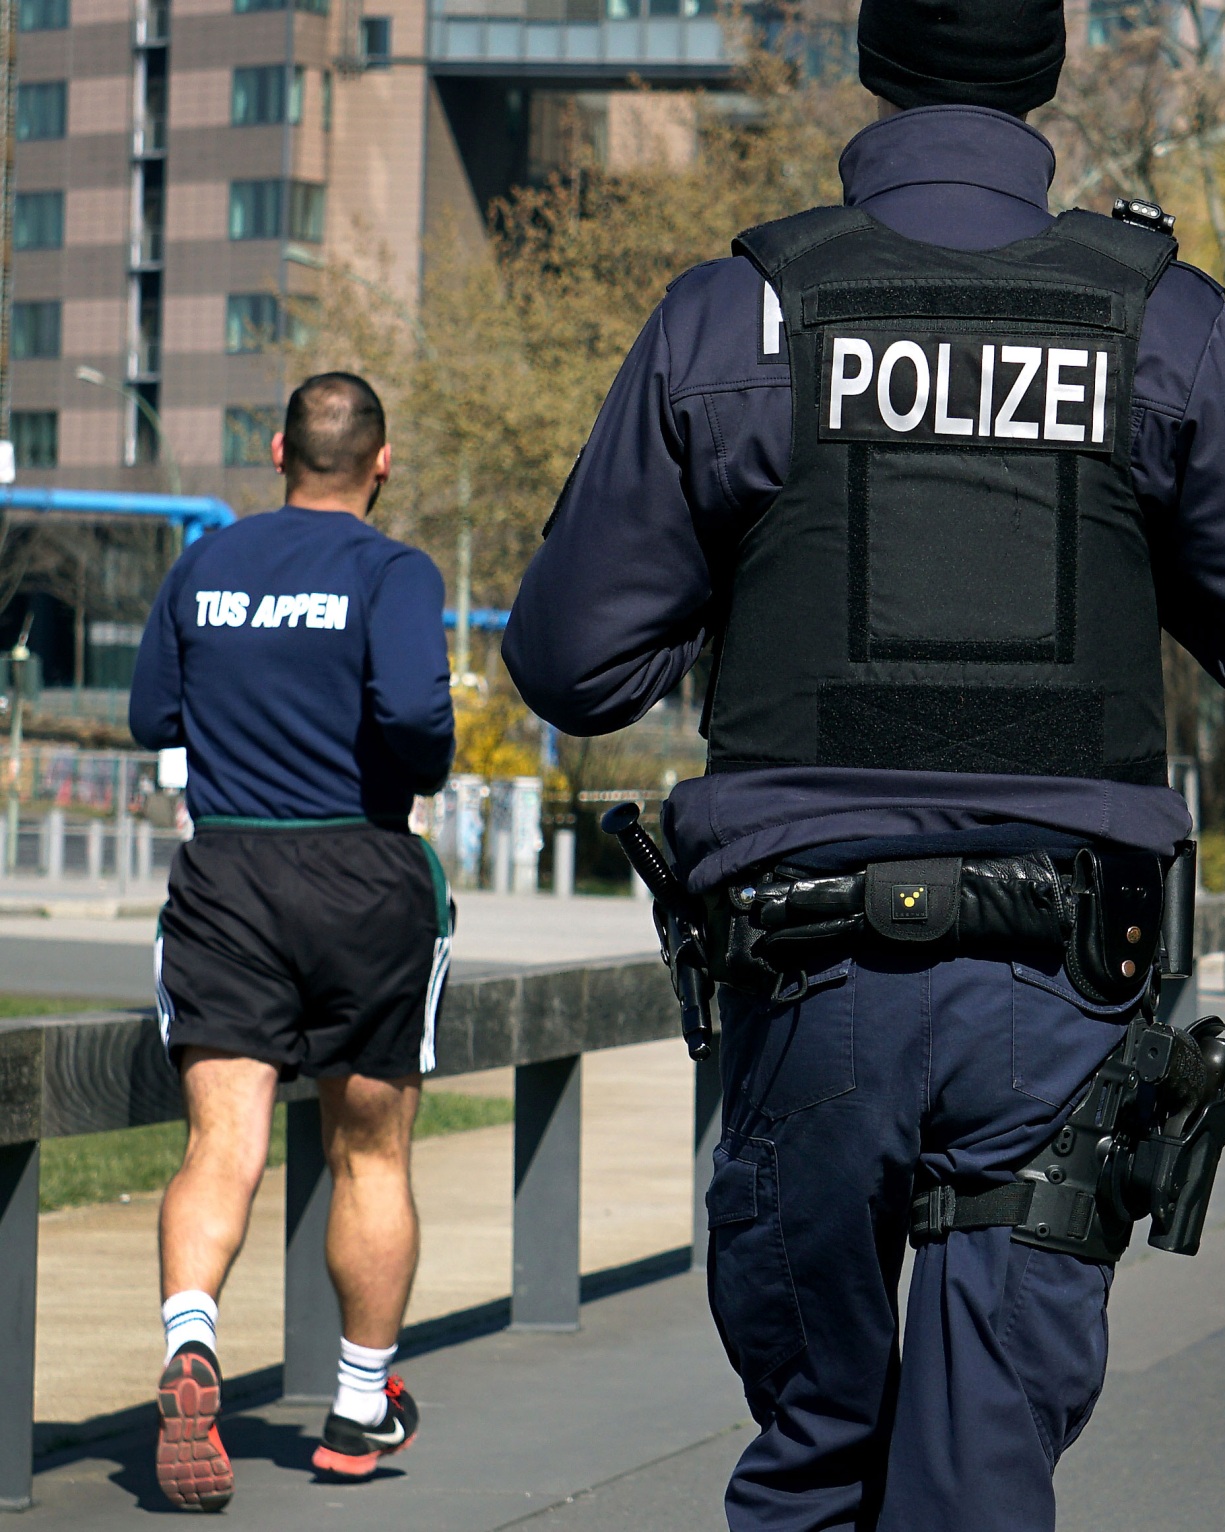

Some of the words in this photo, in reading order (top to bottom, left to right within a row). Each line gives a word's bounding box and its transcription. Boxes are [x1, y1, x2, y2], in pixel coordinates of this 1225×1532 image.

[829, 336, 1108, 444] POLIZEI
[195, 590, 251, 627] TUS
[250, 592, 349, 630] APPEN
